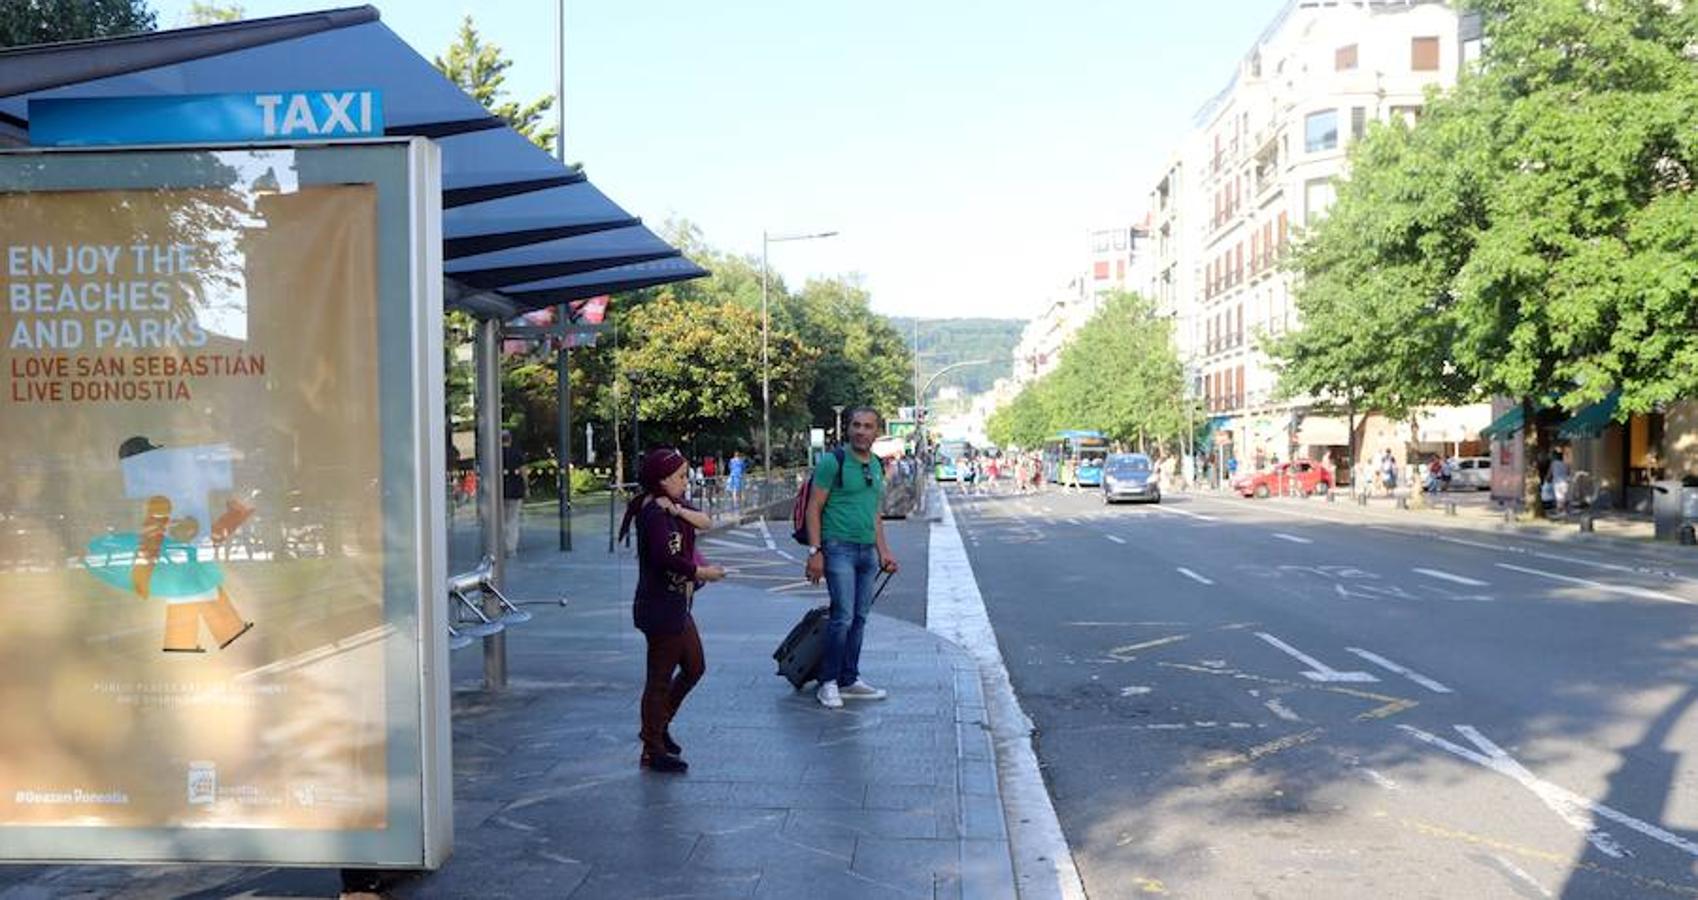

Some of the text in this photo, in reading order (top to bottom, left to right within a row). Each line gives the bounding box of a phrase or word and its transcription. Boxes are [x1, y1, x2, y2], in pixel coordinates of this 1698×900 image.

[256, 92, 372, 135] TAXI
[9, 244, 198, 276] ENJOY THE
[9, 281, 171, 313] BEACHES
[10, 318, 208, 348] AND PARKS
[11, 349, 266, 378] LOVE SAN SEBASTIÁN
[11, 381, 192, 402] LIVE DONOSTIA
